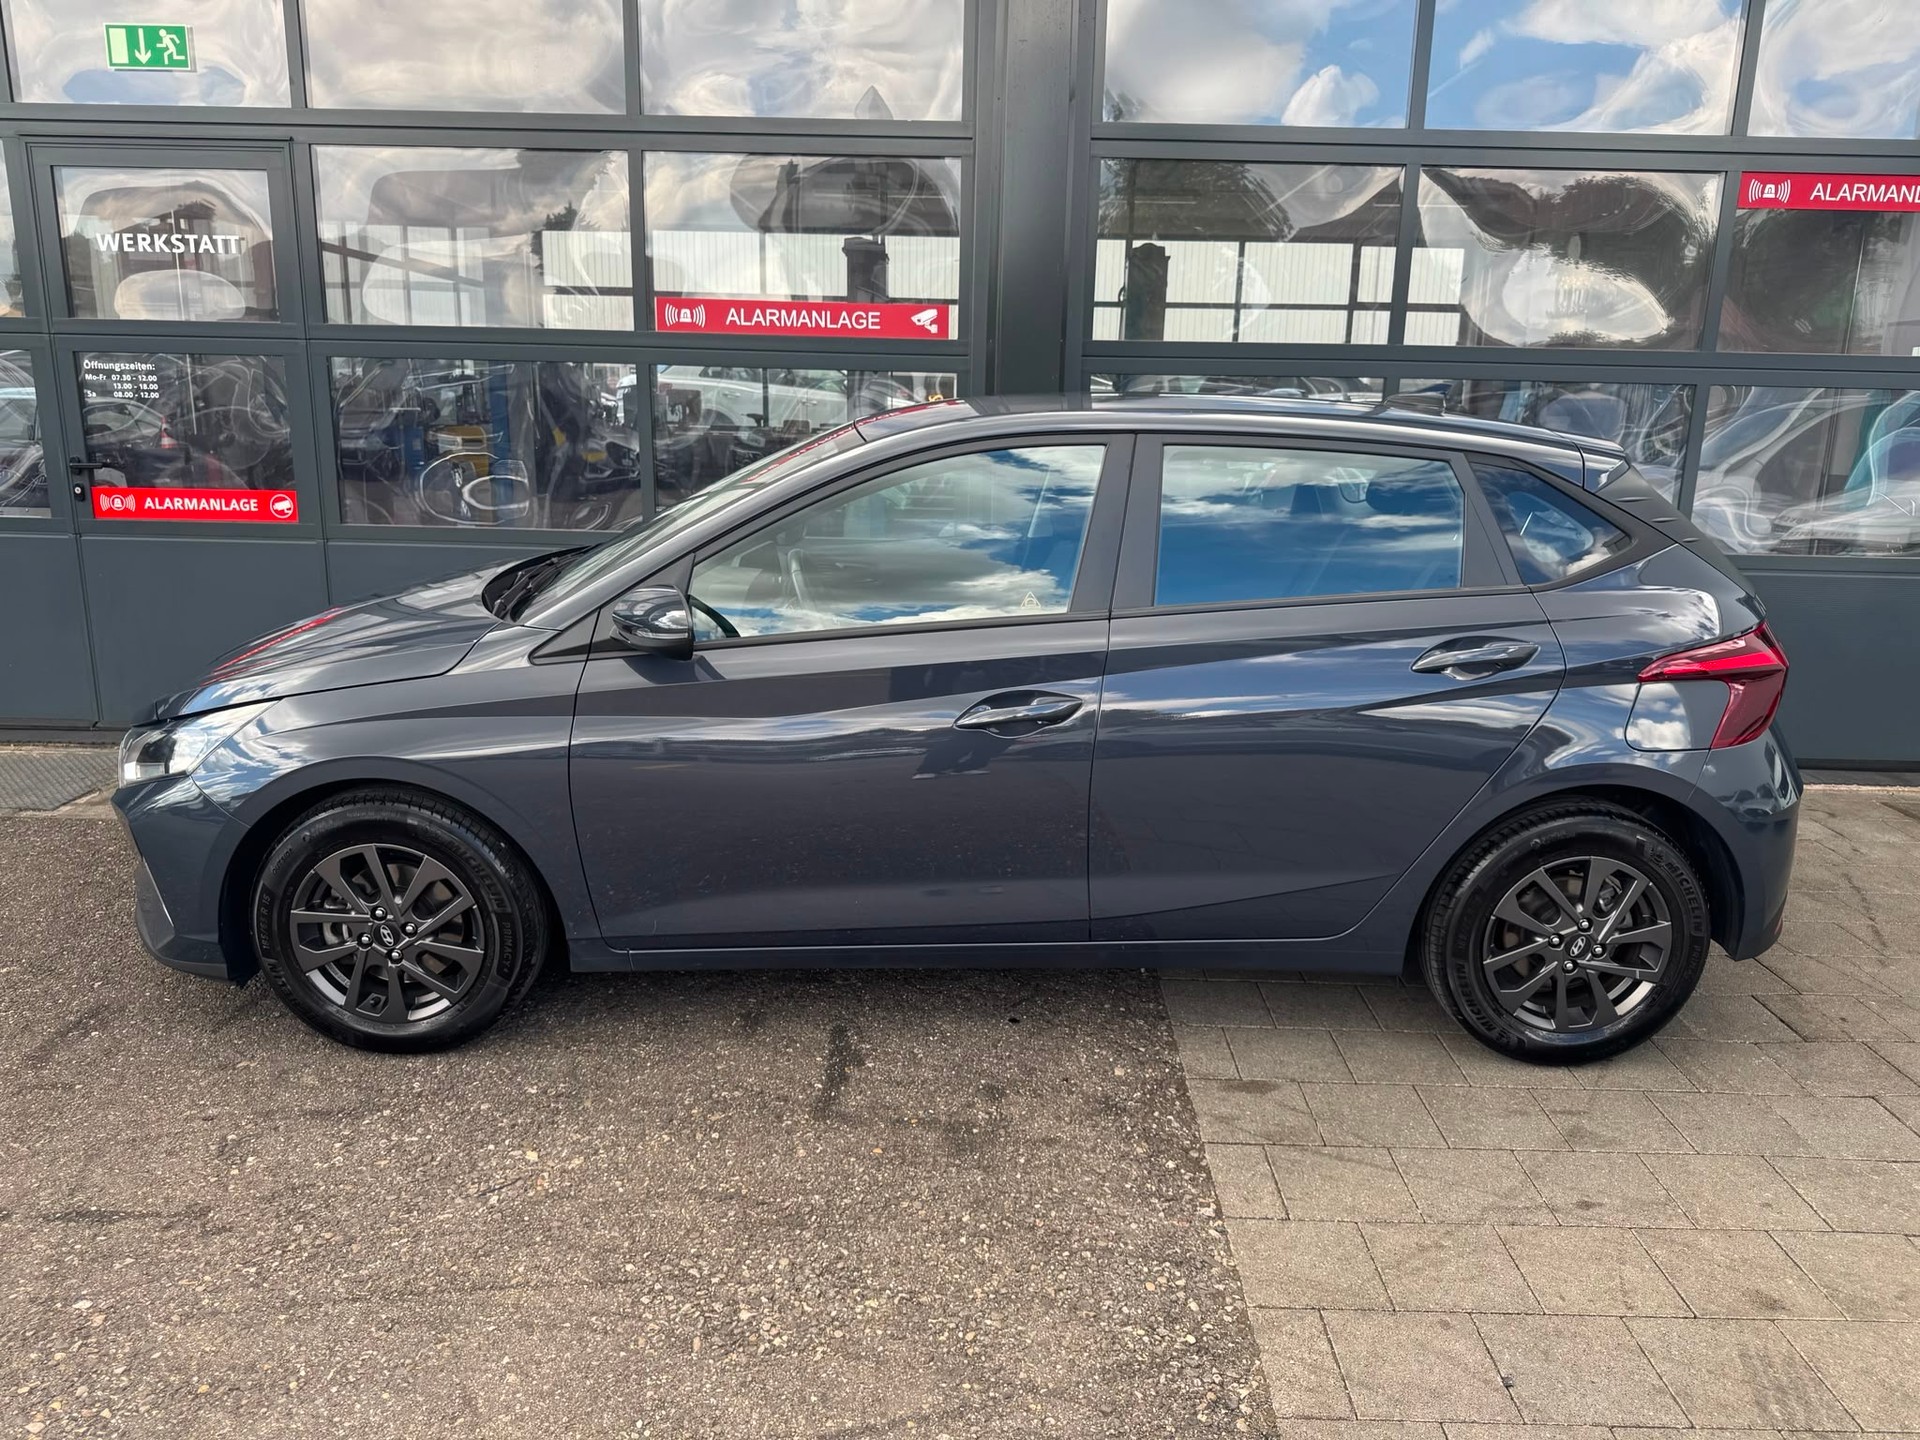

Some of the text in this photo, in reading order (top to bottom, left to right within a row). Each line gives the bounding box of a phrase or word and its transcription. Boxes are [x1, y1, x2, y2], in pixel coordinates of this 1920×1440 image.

[96, 232, 240, 254] WERKSTATT
[726, 308, 881, 330] ALARMANLAGE
[83, 359, 156, 372] Öffnungszeiten:
[85, 373, 107, 381] Mo-Fr
[87, 390, 97, 398] Sa
[144, 496, 259, 512] ALARMANLAGE
[1667, 861, 1703, 934] MICHELIN
[1456, 962, 1498, 1036] MICHELIN
